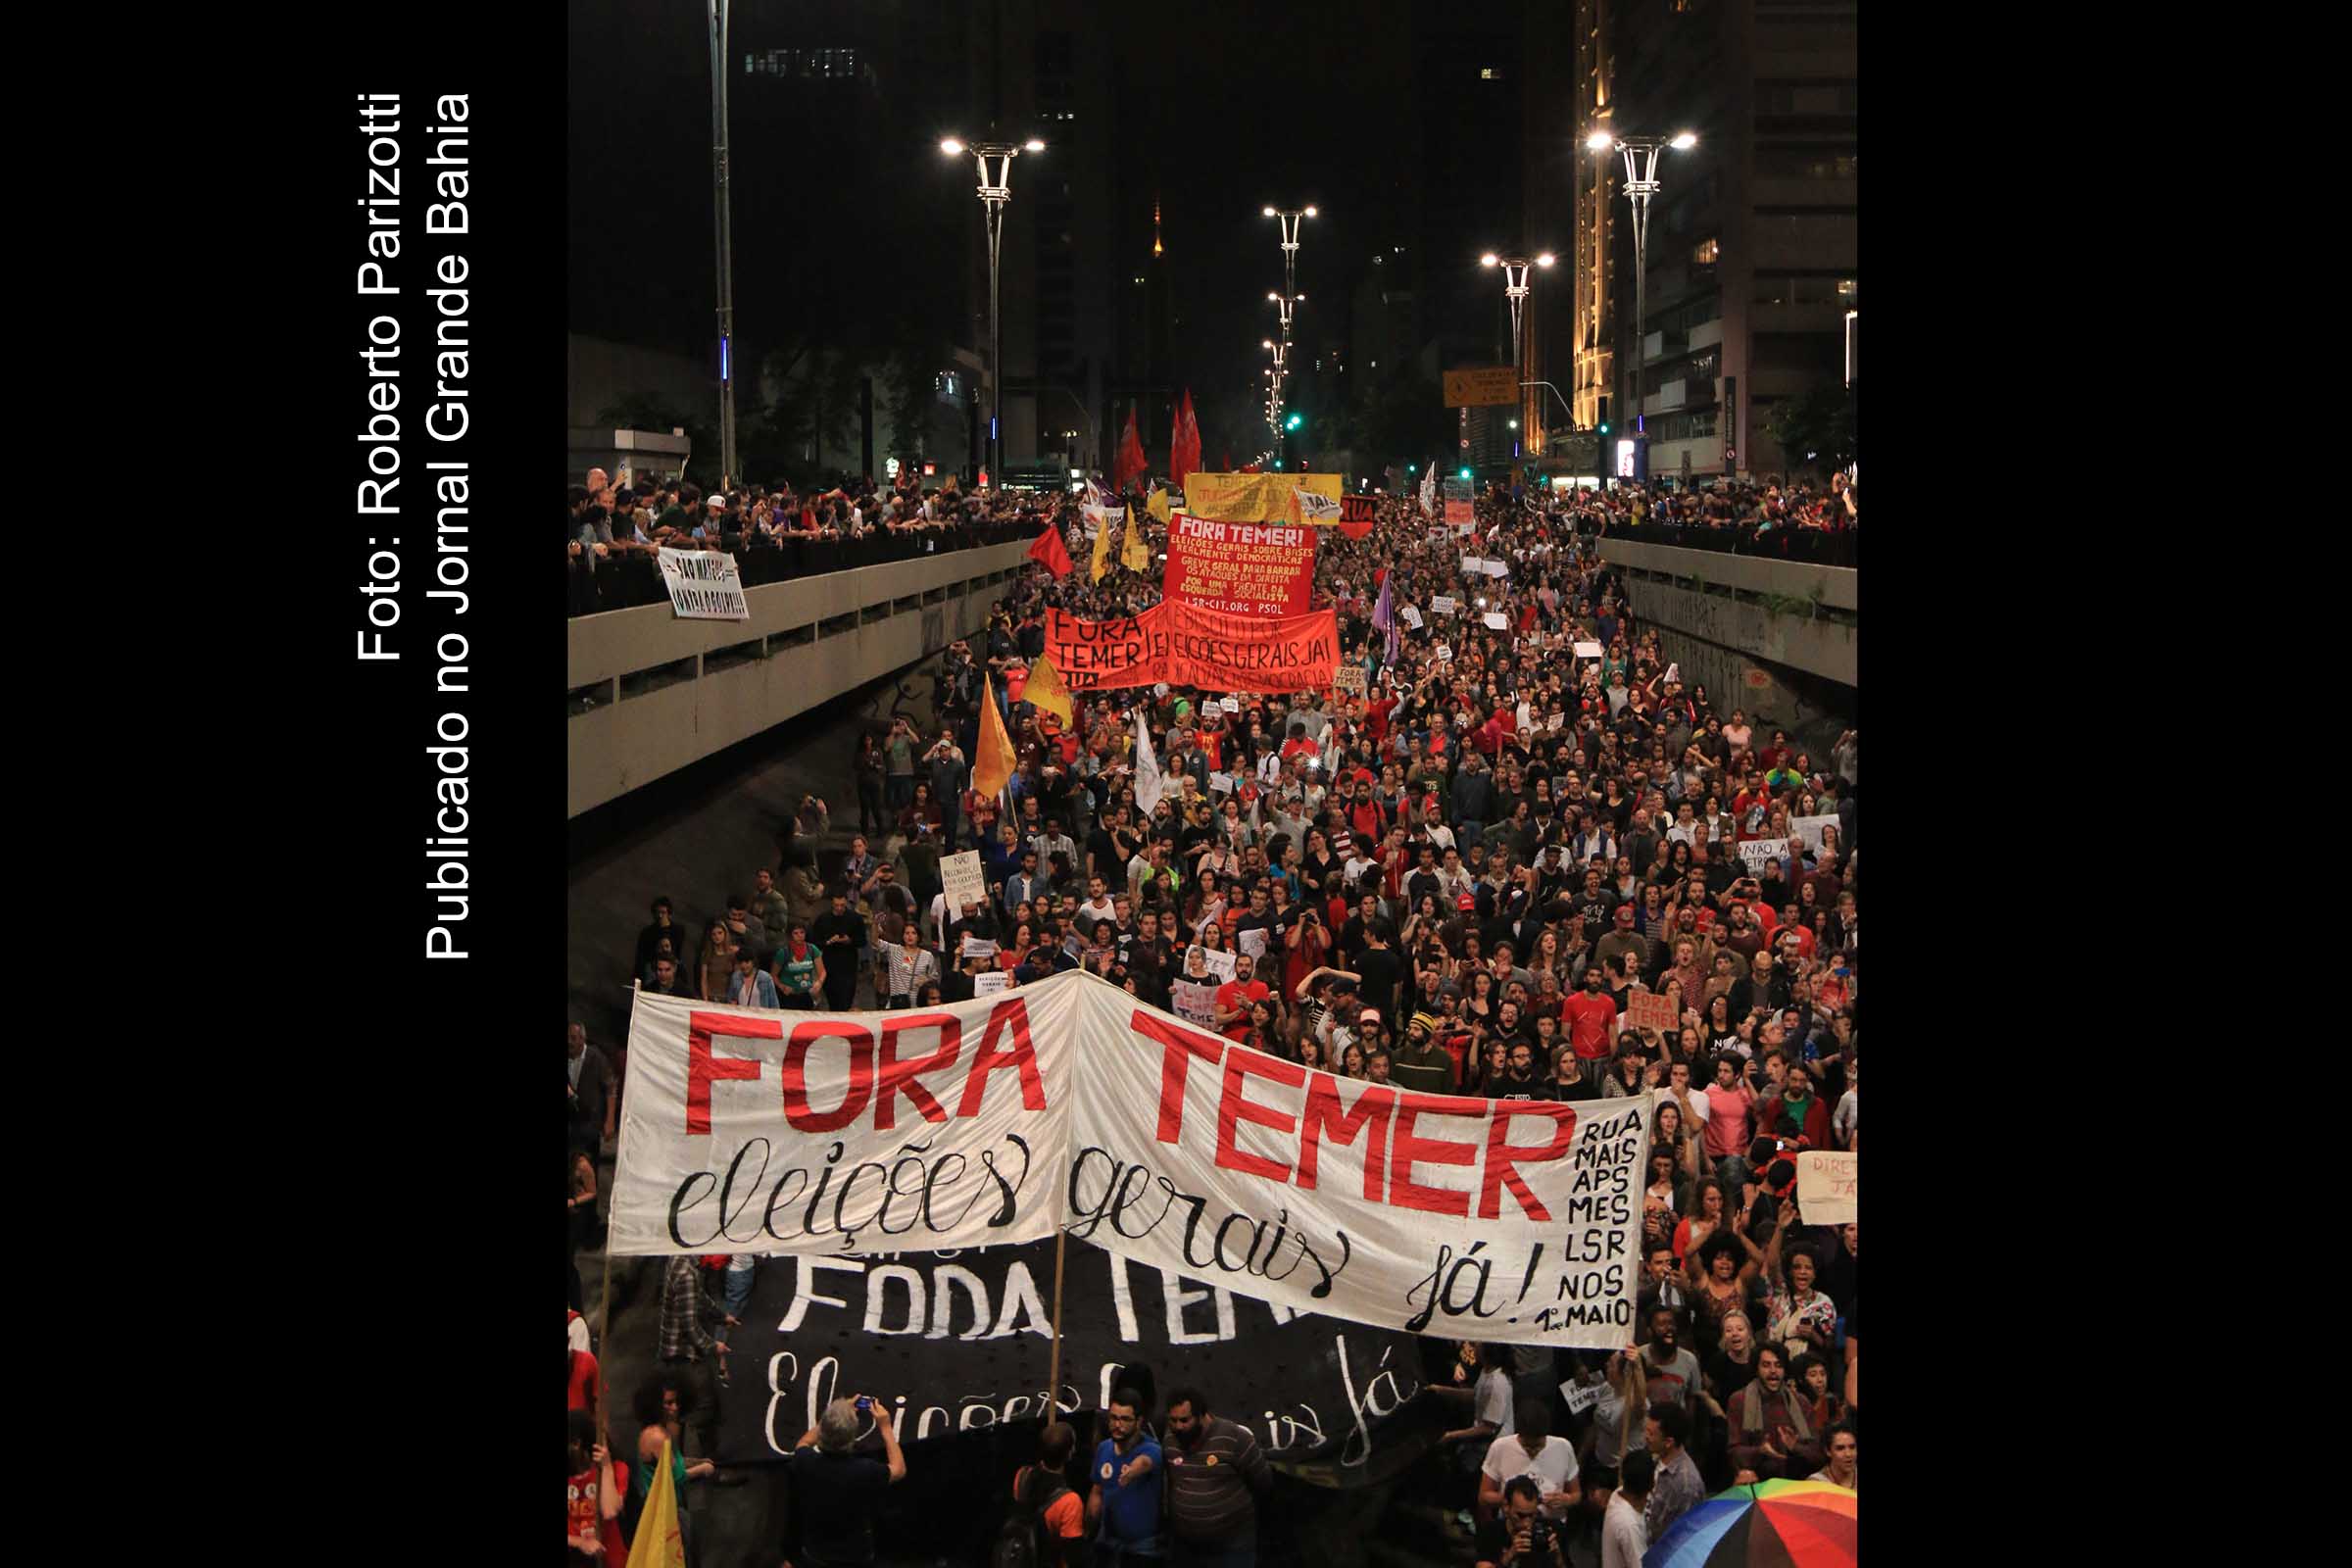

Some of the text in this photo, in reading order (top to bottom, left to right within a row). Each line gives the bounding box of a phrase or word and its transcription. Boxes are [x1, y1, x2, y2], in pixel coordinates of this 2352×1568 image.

[1179, 515, 1303, 548] FORA TEMER!
[1170, 534, 1314, 558] ELEIÇÕES GERAIS SOBRE BASES
[1176, 545, 1231, 560] REALMENTE
[1181, 556, 1210, 568] GREVE
[1212, 562, 1240, 574] GERAL
[1243, 564, 1266, 574] PARA
[1186, 565, 1291, 585] OS ATAQUES DA DIREITA
[1180, 583, 1289, 603] ESQUERDA SOCIALISTA
[1186, 575, 1202, 586] POR
[1209, 579, 1227, 589] UMA
[1233, 582, 1270, 593] FRENTE
[1258, 604, 1284, 614] PSOL
[1055, 611, 1143, 643] FORA
[1055, 642, 1141, 668] TEMER
[1234, 642, 1299, 670] GERAIS
[1630, 991, 1673, 1009] FORA
[1629, 1006, 1679, 1029] TEMER
[686, 996, 1047, 1136] FORA
[1130, 1008, 1578, 1222] TEMER
[1582, 1108, 1642, 1145] RUA
[667, 1133, 1030, 1250] eleições
[1572, 1166, 1629, 1194] APS
[1062, 1147, 1349, 1298] gerais
[1568, 1194, 1630, 1225] MES
[1565, 1229, 1625, 1262] LSR
[1557, 1264, 1624, 1300] NOS
